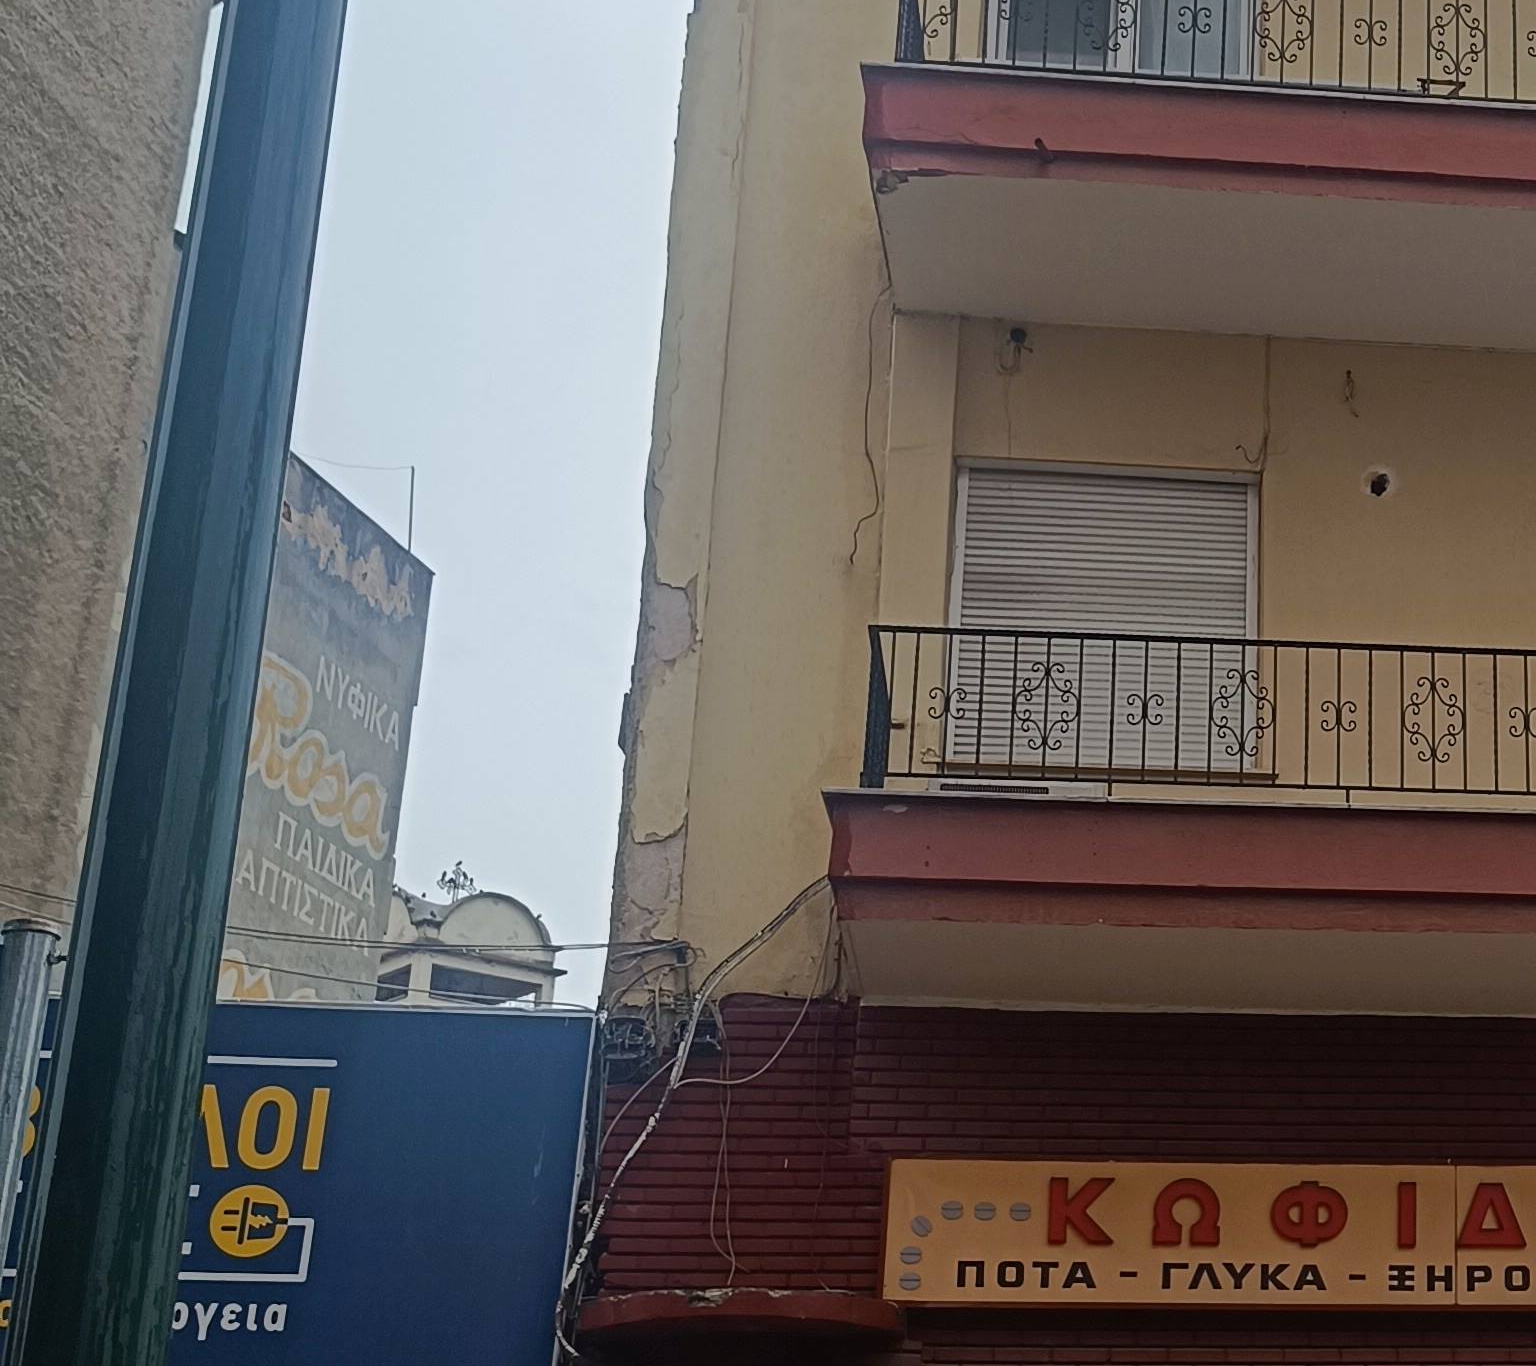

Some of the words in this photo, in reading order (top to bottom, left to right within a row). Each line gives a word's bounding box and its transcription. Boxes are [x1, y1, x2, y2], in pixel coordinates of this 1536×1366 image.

[316, 655, 400, 752] ΝΥΦΙΚΑ
[235, 849, 369, 957] ΑΠΤΙΣΤΙΚΑ
[274, 810, 377, 908] ΠΑΙΔΙΚΑ
[956, 1260, 1097, 1290] ΠΟΤΑ
[1160, 1261, 1328, 1291] ΓΛΥΚΑ
